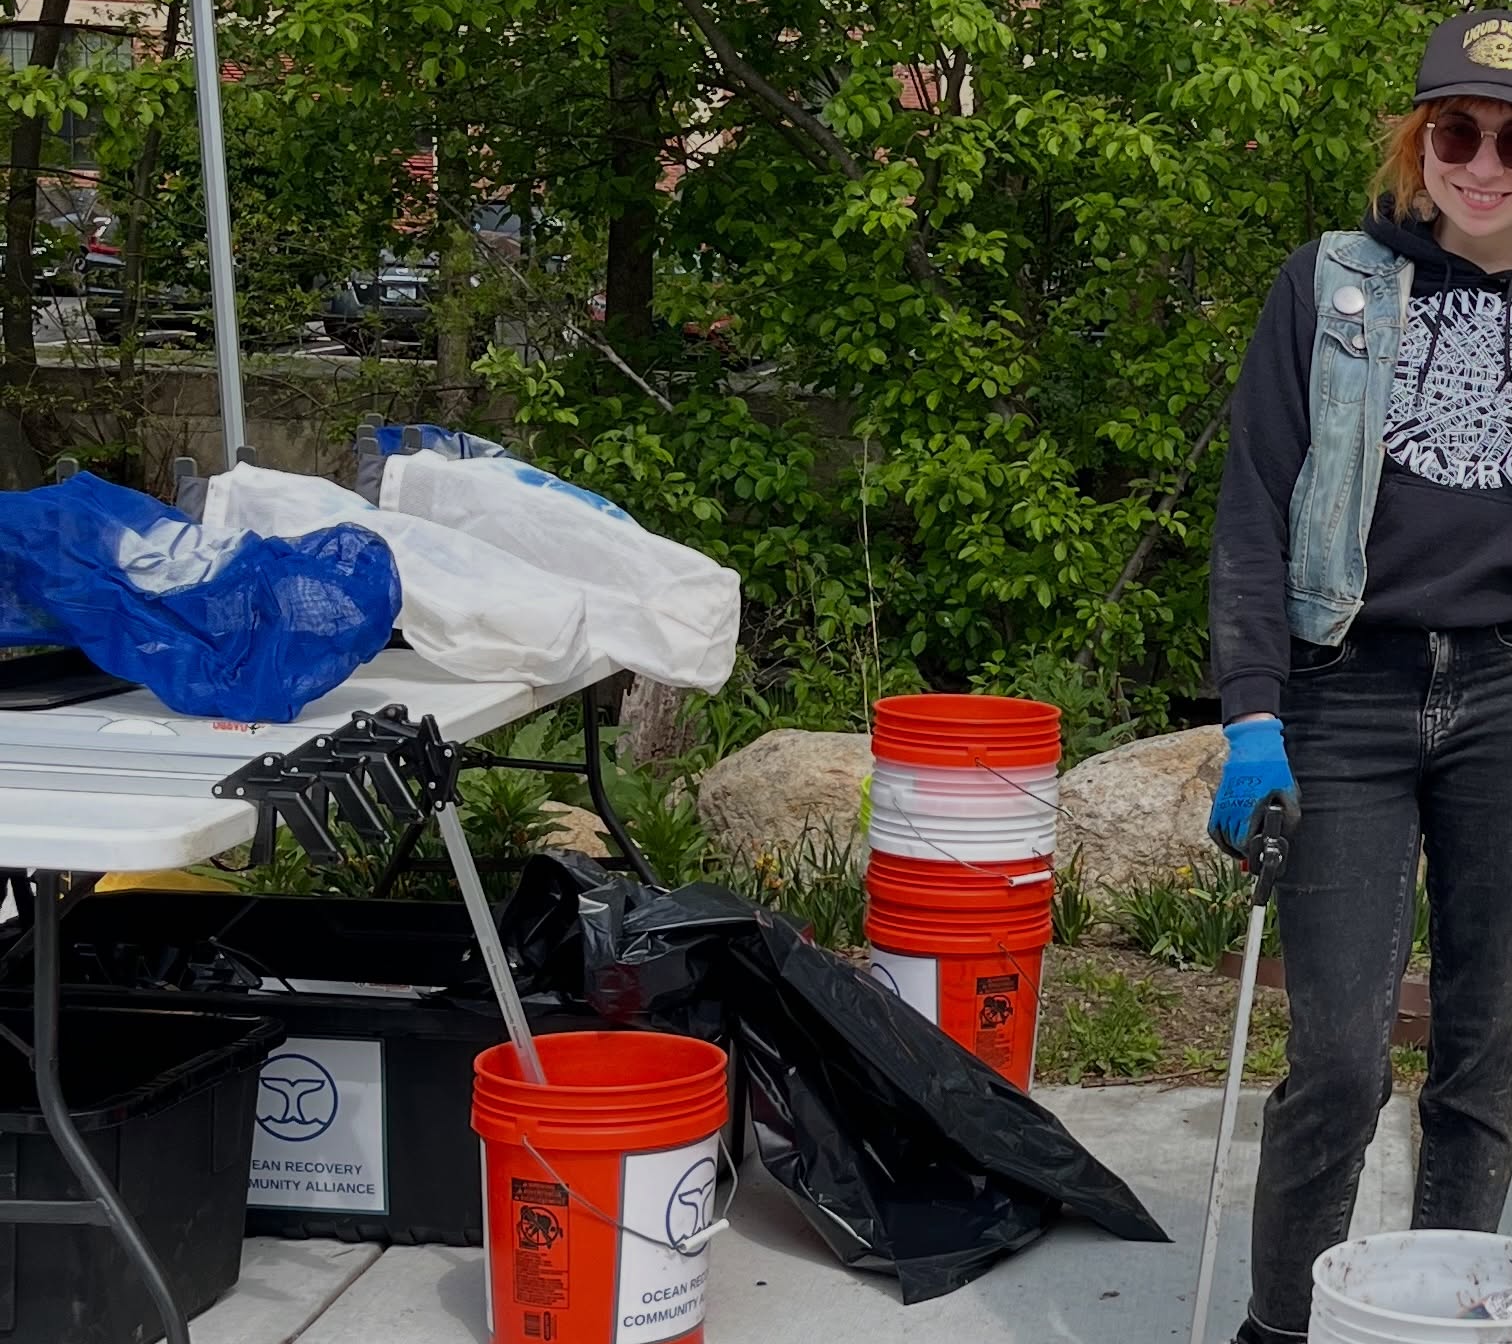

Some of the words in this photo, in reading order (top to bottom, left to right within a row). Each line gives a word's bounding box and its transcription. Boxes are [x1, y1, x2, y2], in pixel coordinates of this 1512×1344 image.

[1462, 18, 1500, 49] LIQUID
[251, 1159, 281, 1172] EAN
[284, 1160, 363, 1176] RECOVERY
[248, 1177, 301, 1191] MUNITY
[305, 1180, 376, 1195] ALLIANCE
[641, 1282, 688, 1305] OCEAN
[623, 1296, 699, 1328] COMMUNITY
